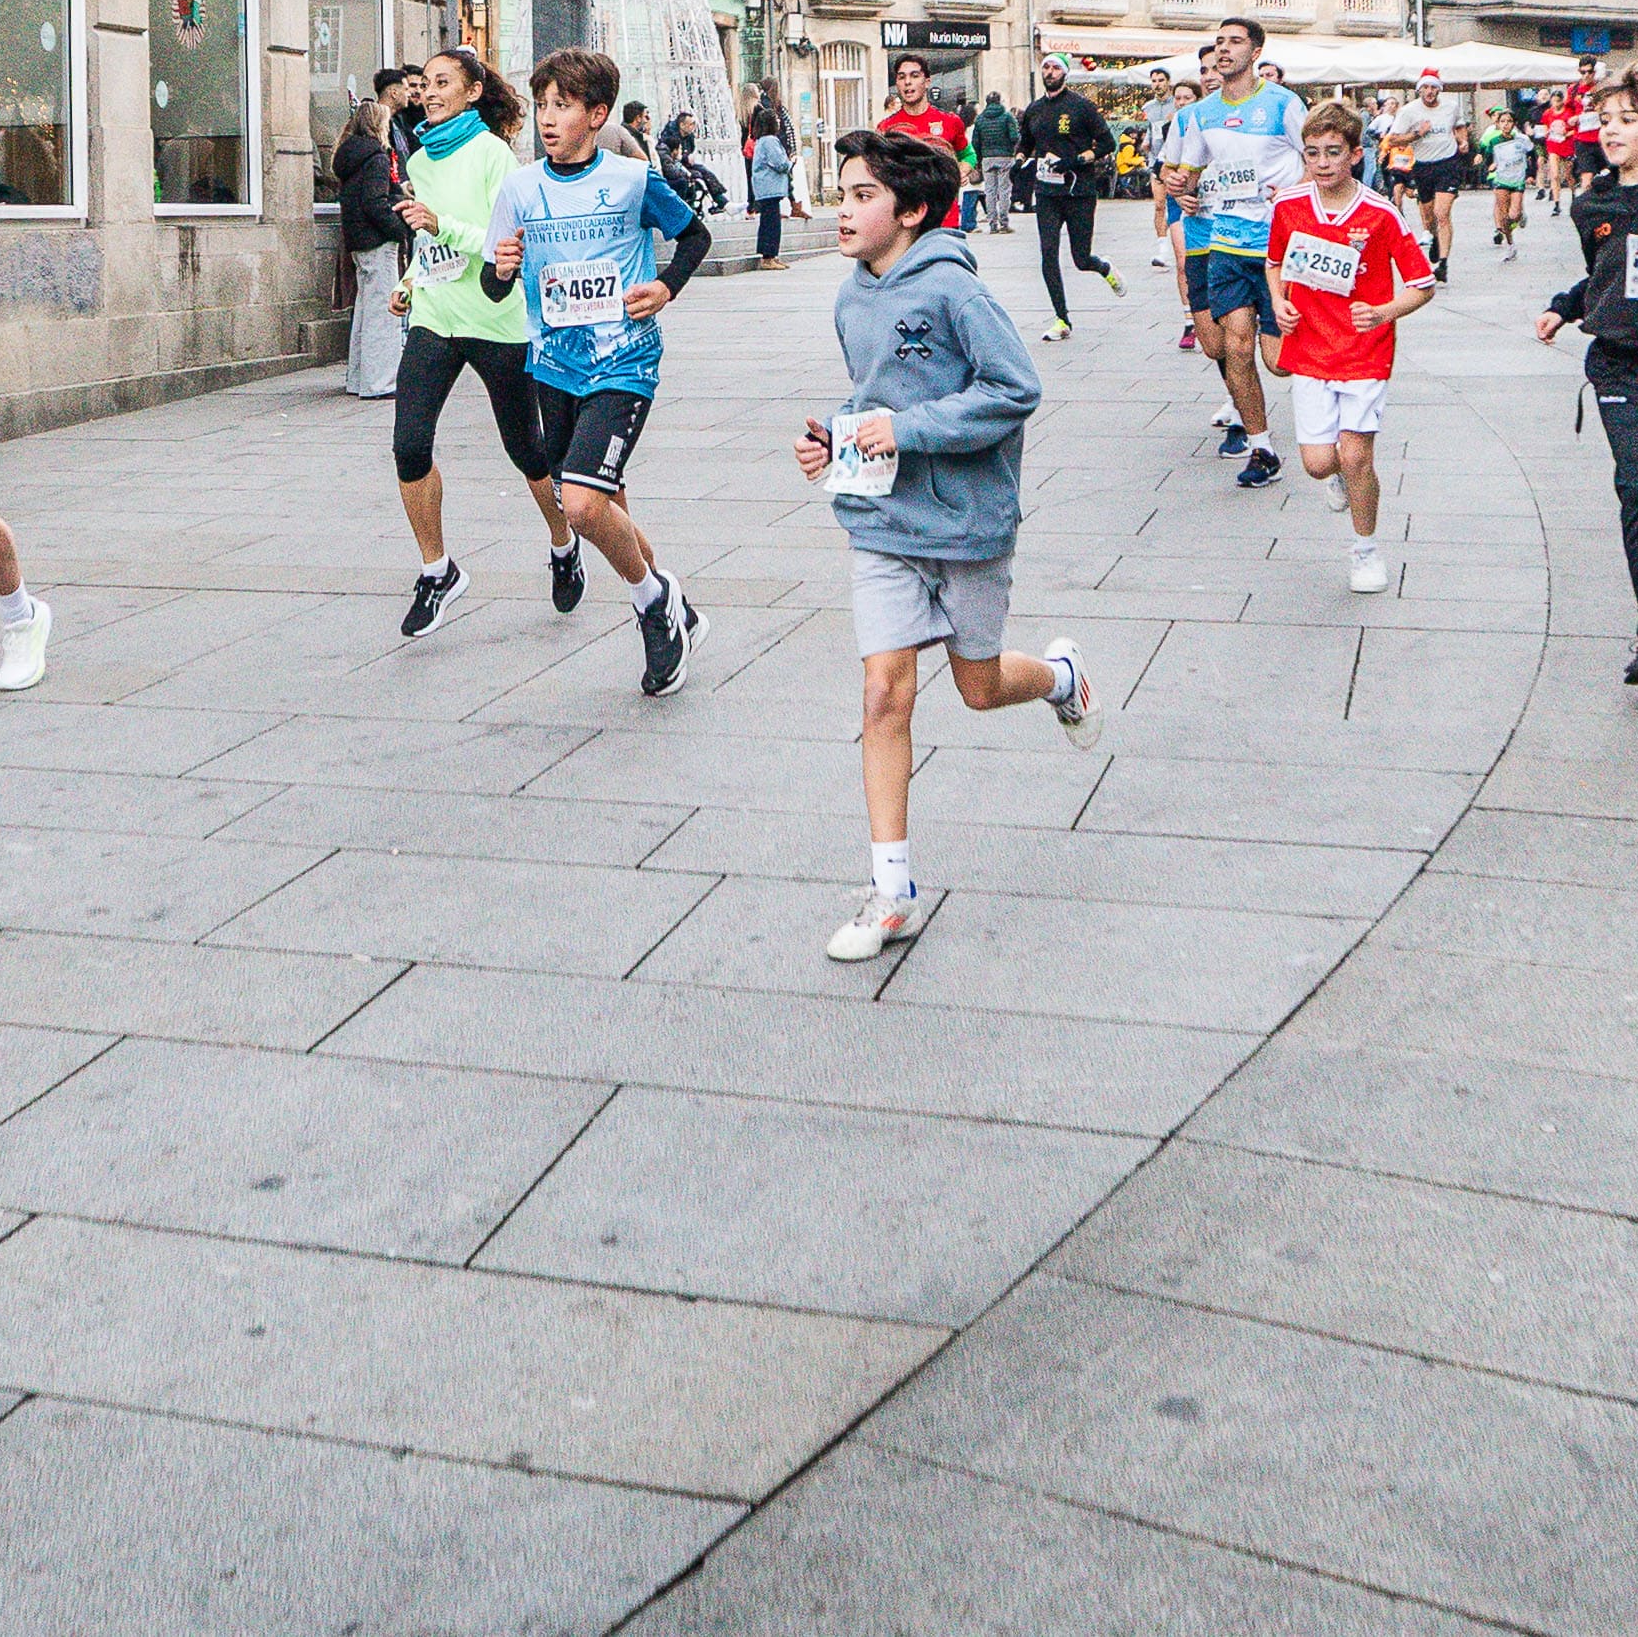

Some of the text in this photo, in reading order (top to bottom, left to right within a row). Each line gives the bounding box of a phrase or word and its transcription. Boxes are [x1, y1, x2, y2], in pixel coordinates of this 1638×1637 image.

[1229, 169, 1256, 184] 2868
[557, 220, 582, 230] FONDO
[527, 228, 604, 243] PONTEVEDRA
[559, 266, 574, 277] SAN
[575, 262, 615, 276] SILVESTRE
[1310, 253, 1352, 279] 2538
[570, 276, 616, 300] 4627
[570, 301, 604, 313] PONTEVEDRA
